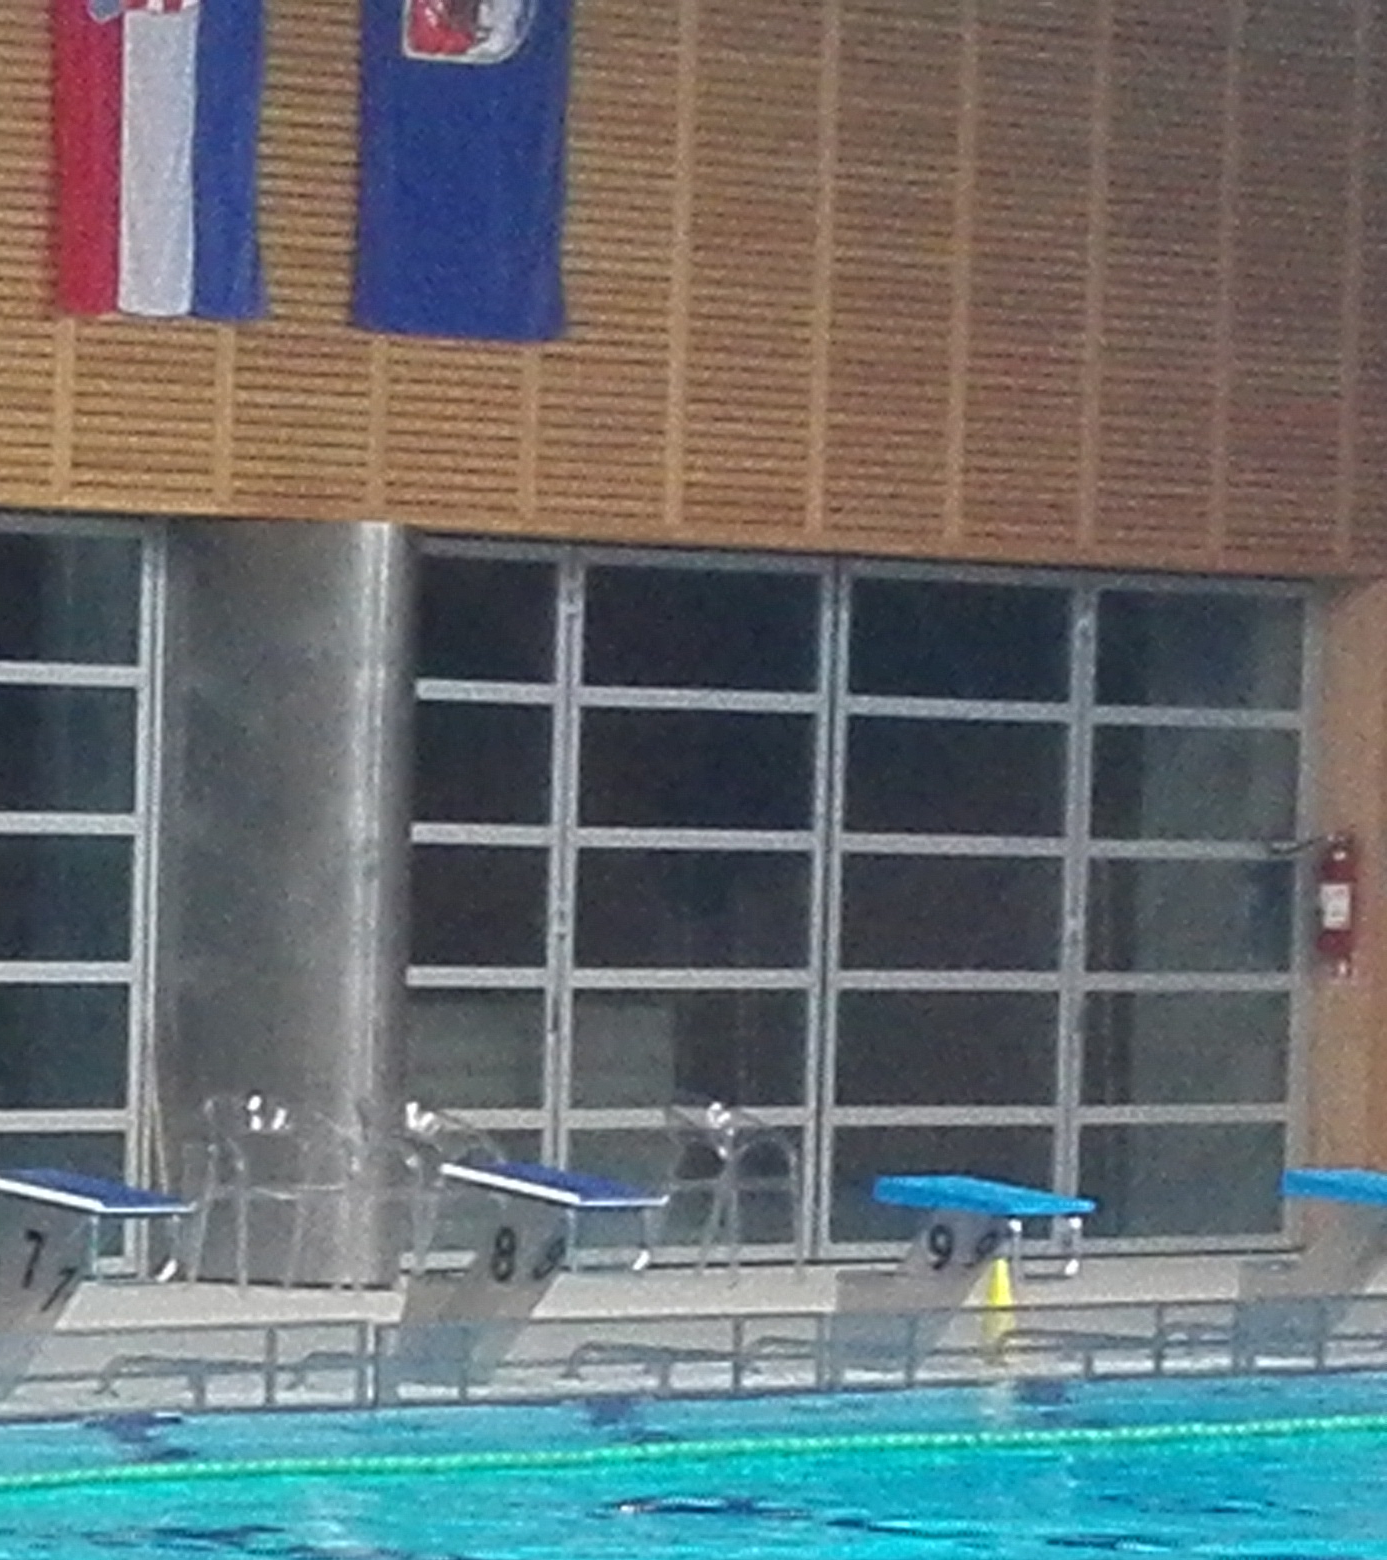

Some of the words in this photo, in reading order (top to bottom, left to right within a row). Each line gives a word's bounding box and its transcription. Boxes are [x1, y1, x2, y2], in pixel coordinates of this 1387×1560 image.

[22, 1229, 44, 1289] 7
[492, 1226, 515, 1283] 8
[929, 1225, 953, 1270] 9
